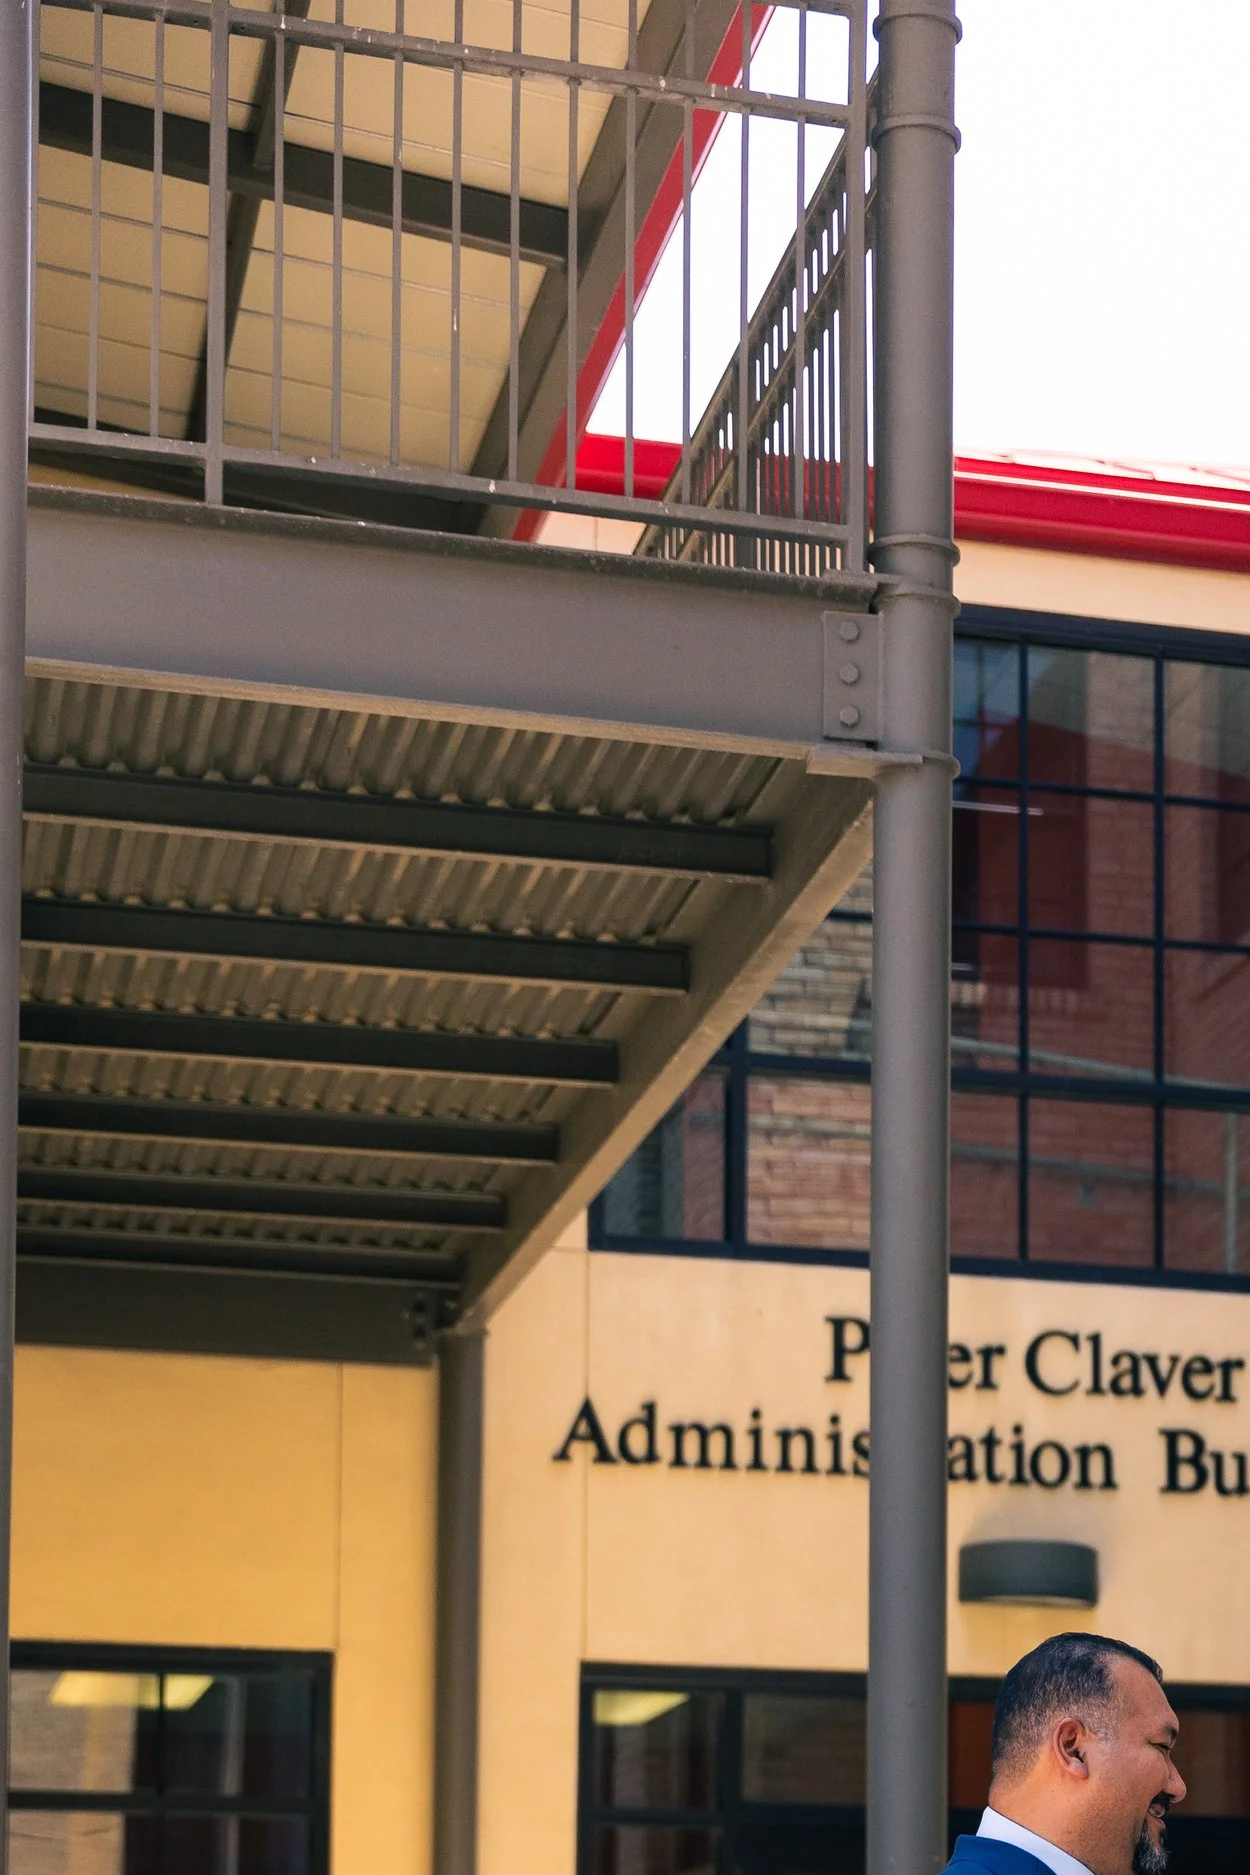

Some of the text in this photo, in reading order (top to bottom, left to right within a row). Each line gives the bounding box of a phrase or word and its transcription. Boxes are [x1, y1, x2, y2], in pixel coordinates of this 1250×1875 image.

[824, 1315, 1245, 1402] Per Claver
[552, 1394, 1118, 1490] Adminisation
